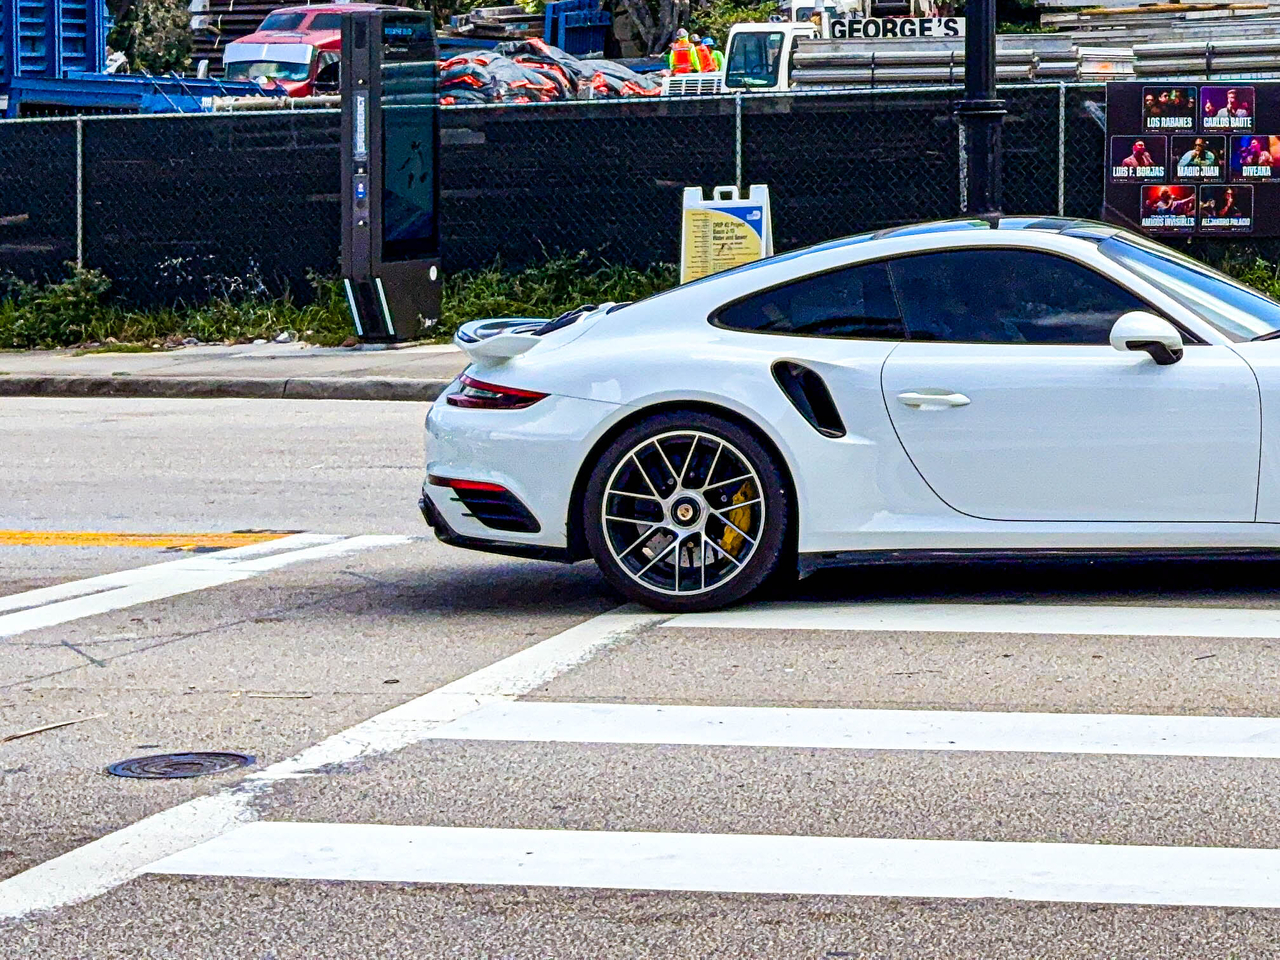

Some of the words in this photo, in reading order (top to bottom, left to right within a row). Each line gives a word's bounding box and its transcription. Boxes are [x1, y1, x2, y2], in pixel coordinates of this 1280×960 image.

[831, 17, 959, 39] GEORGE'S
[1147, 116, 1160, 128] LOS
[1161, 116, 1193, 128] RABANES
[1203, 116, 1230, 128] CARLOS
[1113, 166, 1129, 177] LUIS
[1177, 166, 1200, 177] MAGIC
[1200, 166, 1219, 177] JUAN
